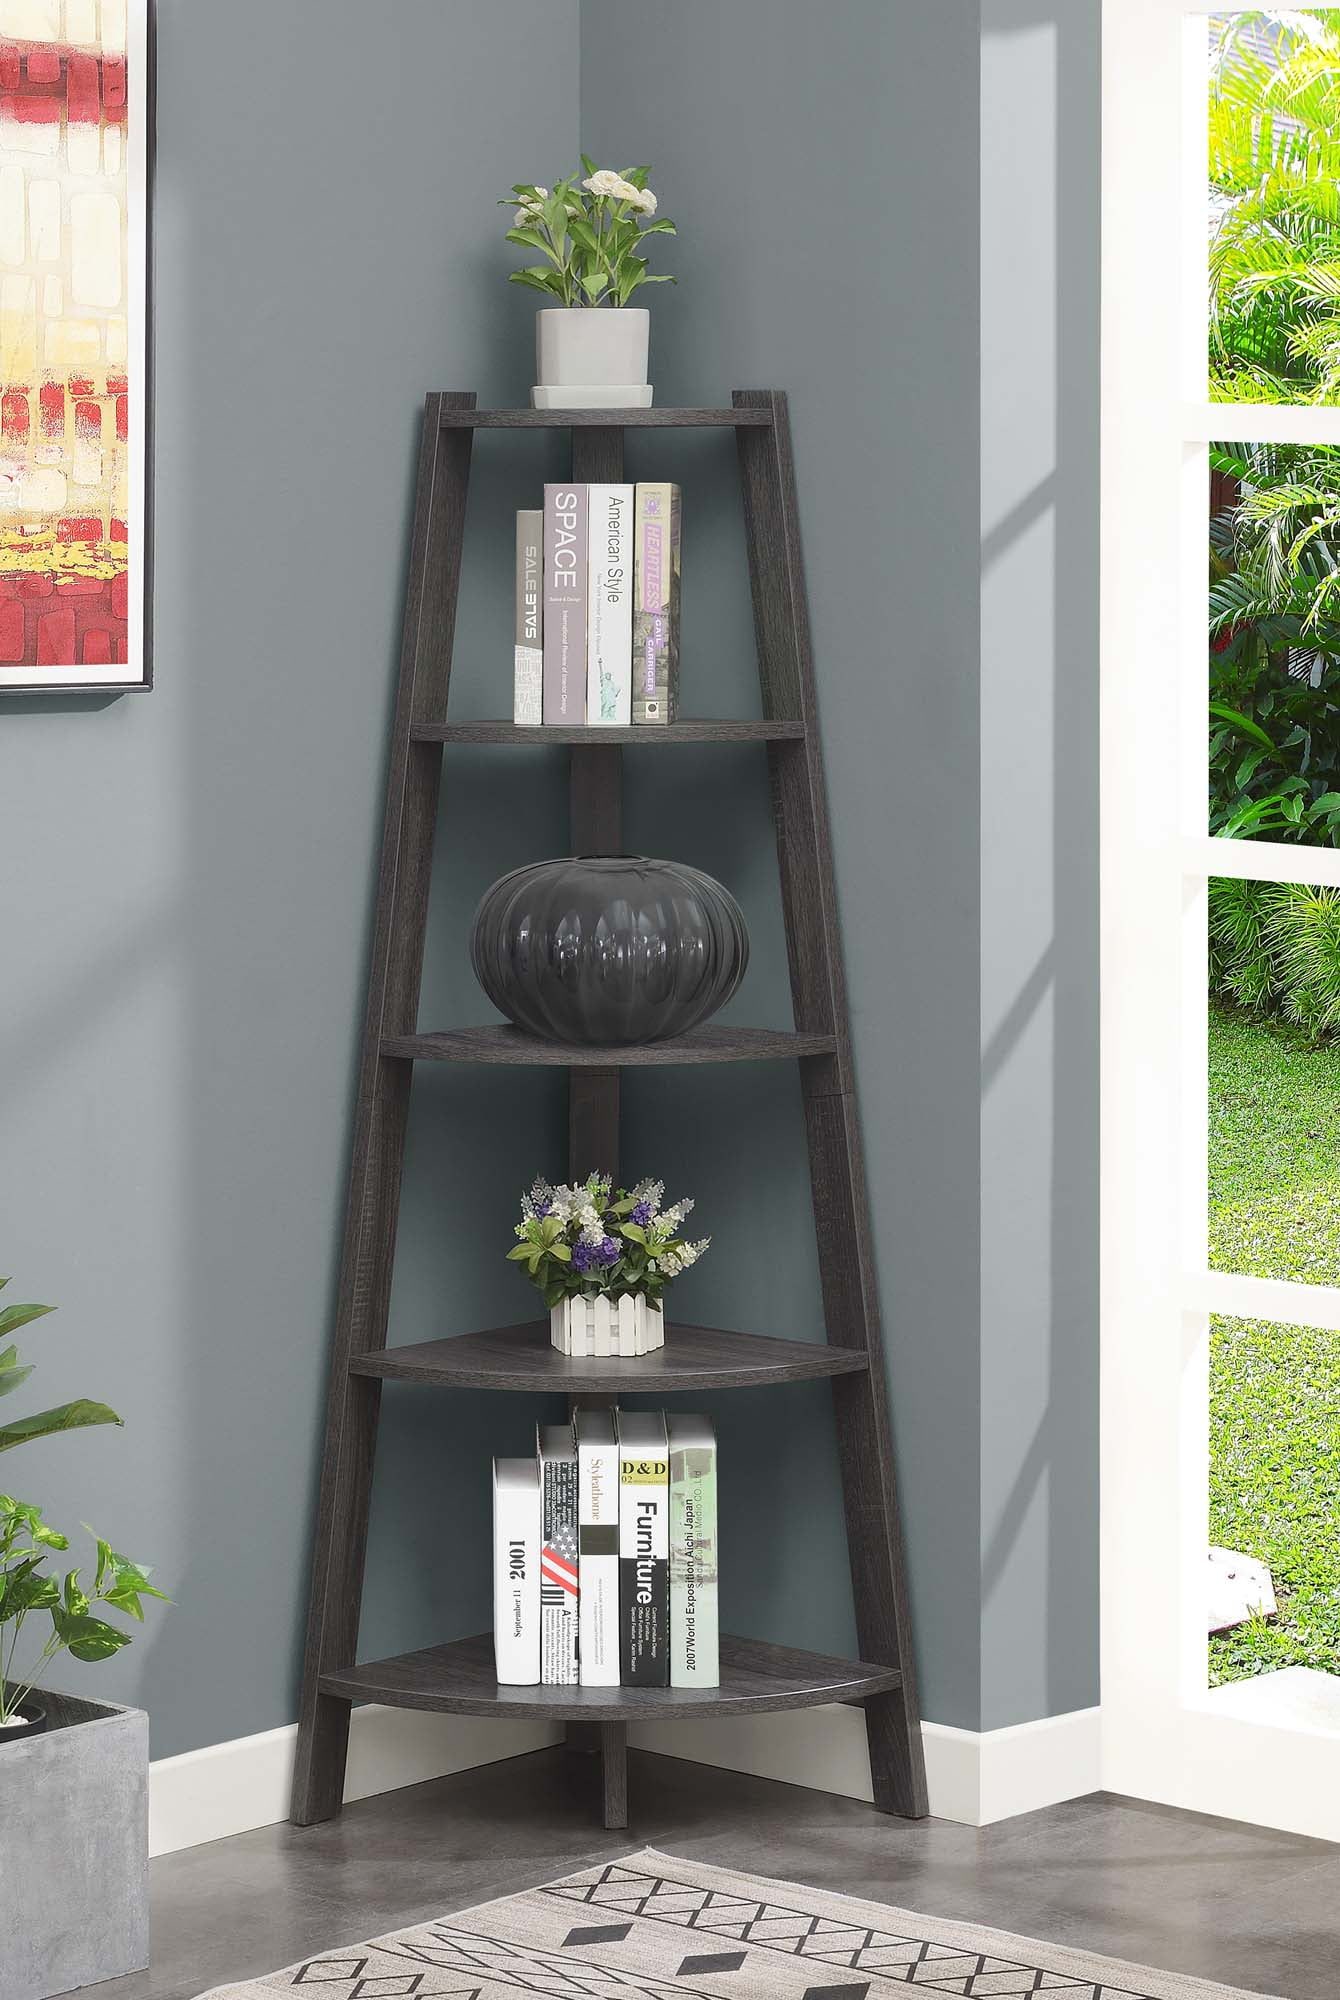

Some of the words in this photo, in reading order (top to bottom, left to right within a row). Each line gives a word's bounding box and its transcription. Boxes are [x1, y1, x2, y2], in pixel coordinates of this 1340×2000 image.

[555, 492, 577, 588] SPACE
[607, 496, 624, 563] American
[603, 568, 624, 603] Style
[646, 526, 661, 609] HEARTLESS
[525, 593, 537, 639] SALE
[622, 1462, 635, 1474] D
[636, 1463, 651, 1474] &
[653, 1463, 666, 1474] D
[683, 1499, 695, 1529] Japan
[509, 1541, 526, 1580] 2001
[636, 1502, 657, 1604] Furniture
[684, 1532, 694, 1558] Aichi
[684, 1561, 696, 1614] Exposition
[513, 1599, 523, 1638] September
